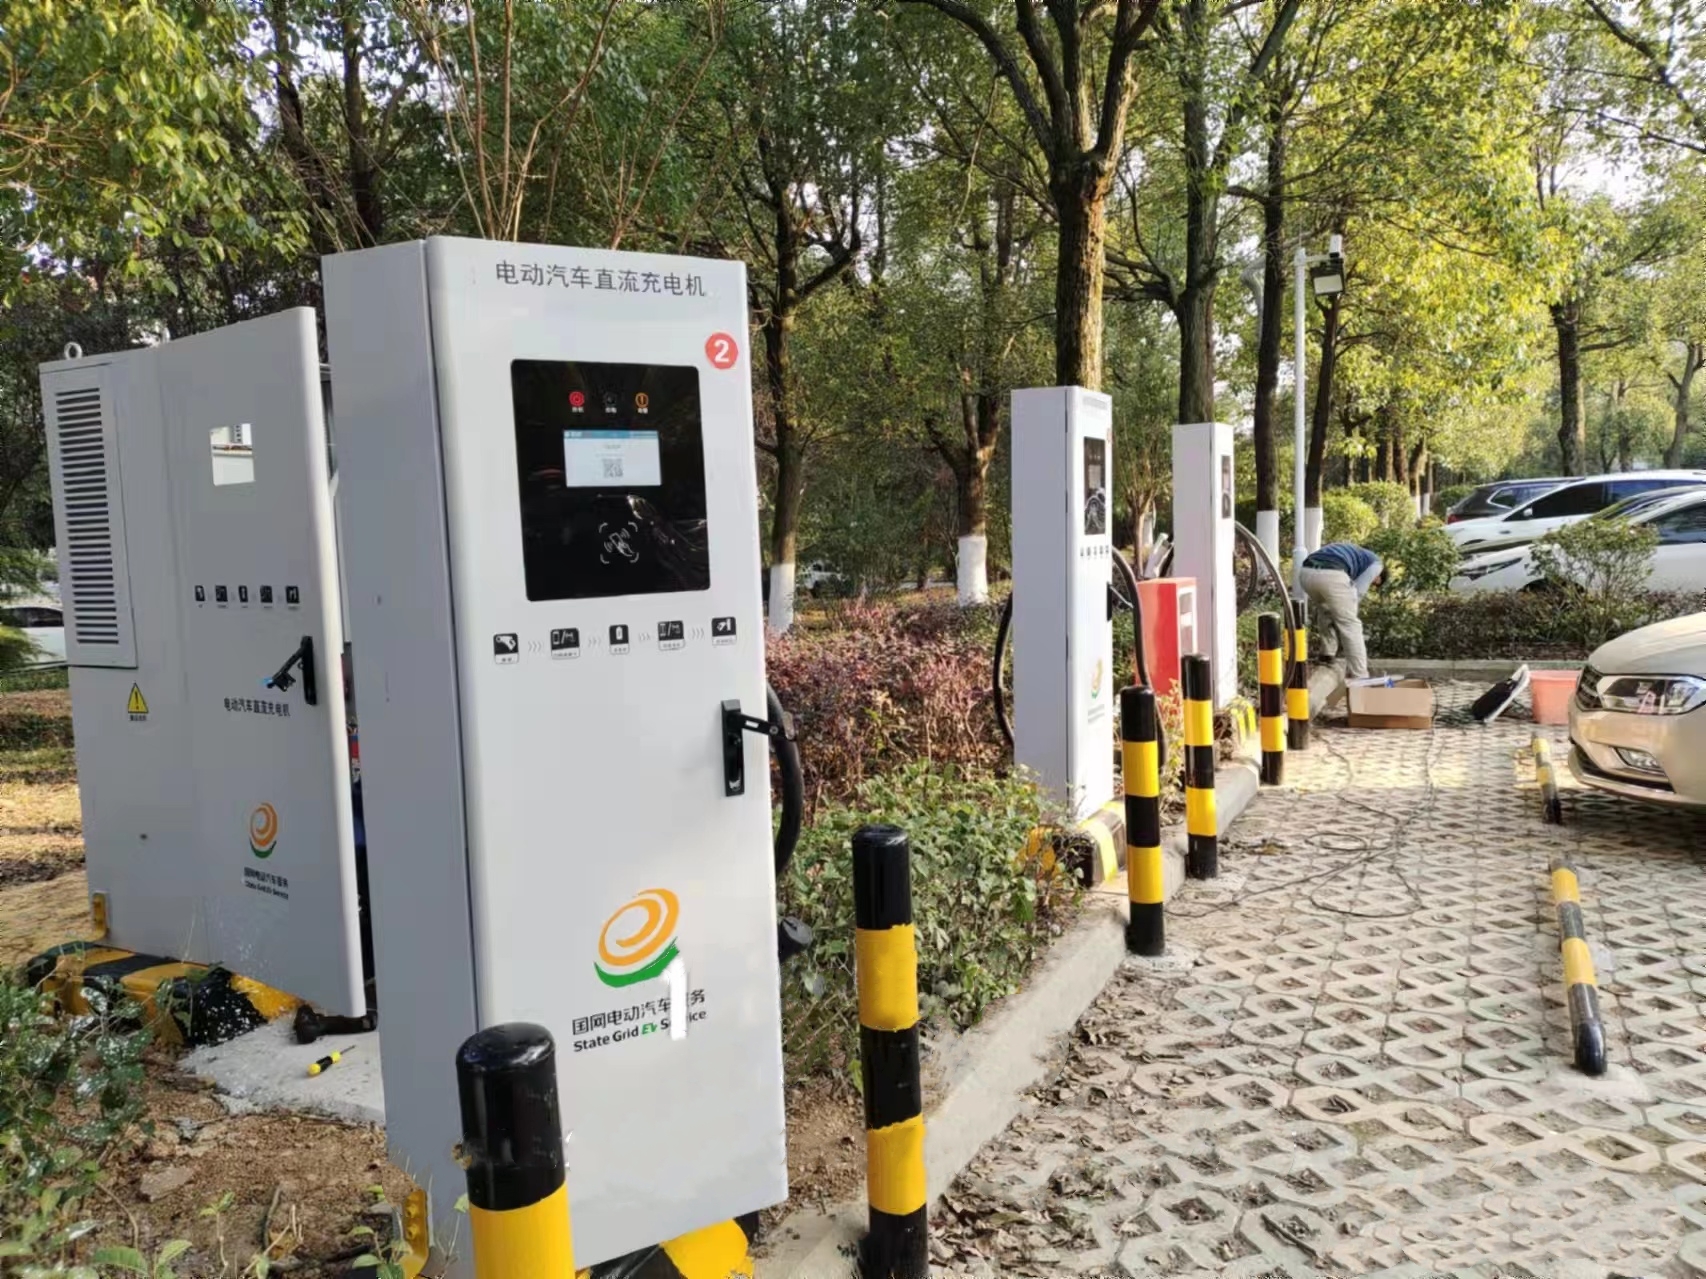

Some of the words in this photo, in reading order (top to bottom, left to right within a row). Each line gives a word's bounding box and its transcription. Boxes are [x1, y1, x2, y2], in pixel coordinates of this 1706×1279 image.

[496, 260, 707, 297] 电动汽车直流充电机
[713, 339, 731, 363] 2
[571, 988, 706, 1036] 国网电动汽车务
[573, 1034, 611, 1053] State
[612, 1025, 640, 1043] Grid
[641, 1022, 658, 1035] EV
[660, 1010, 707, 1031] Sice
